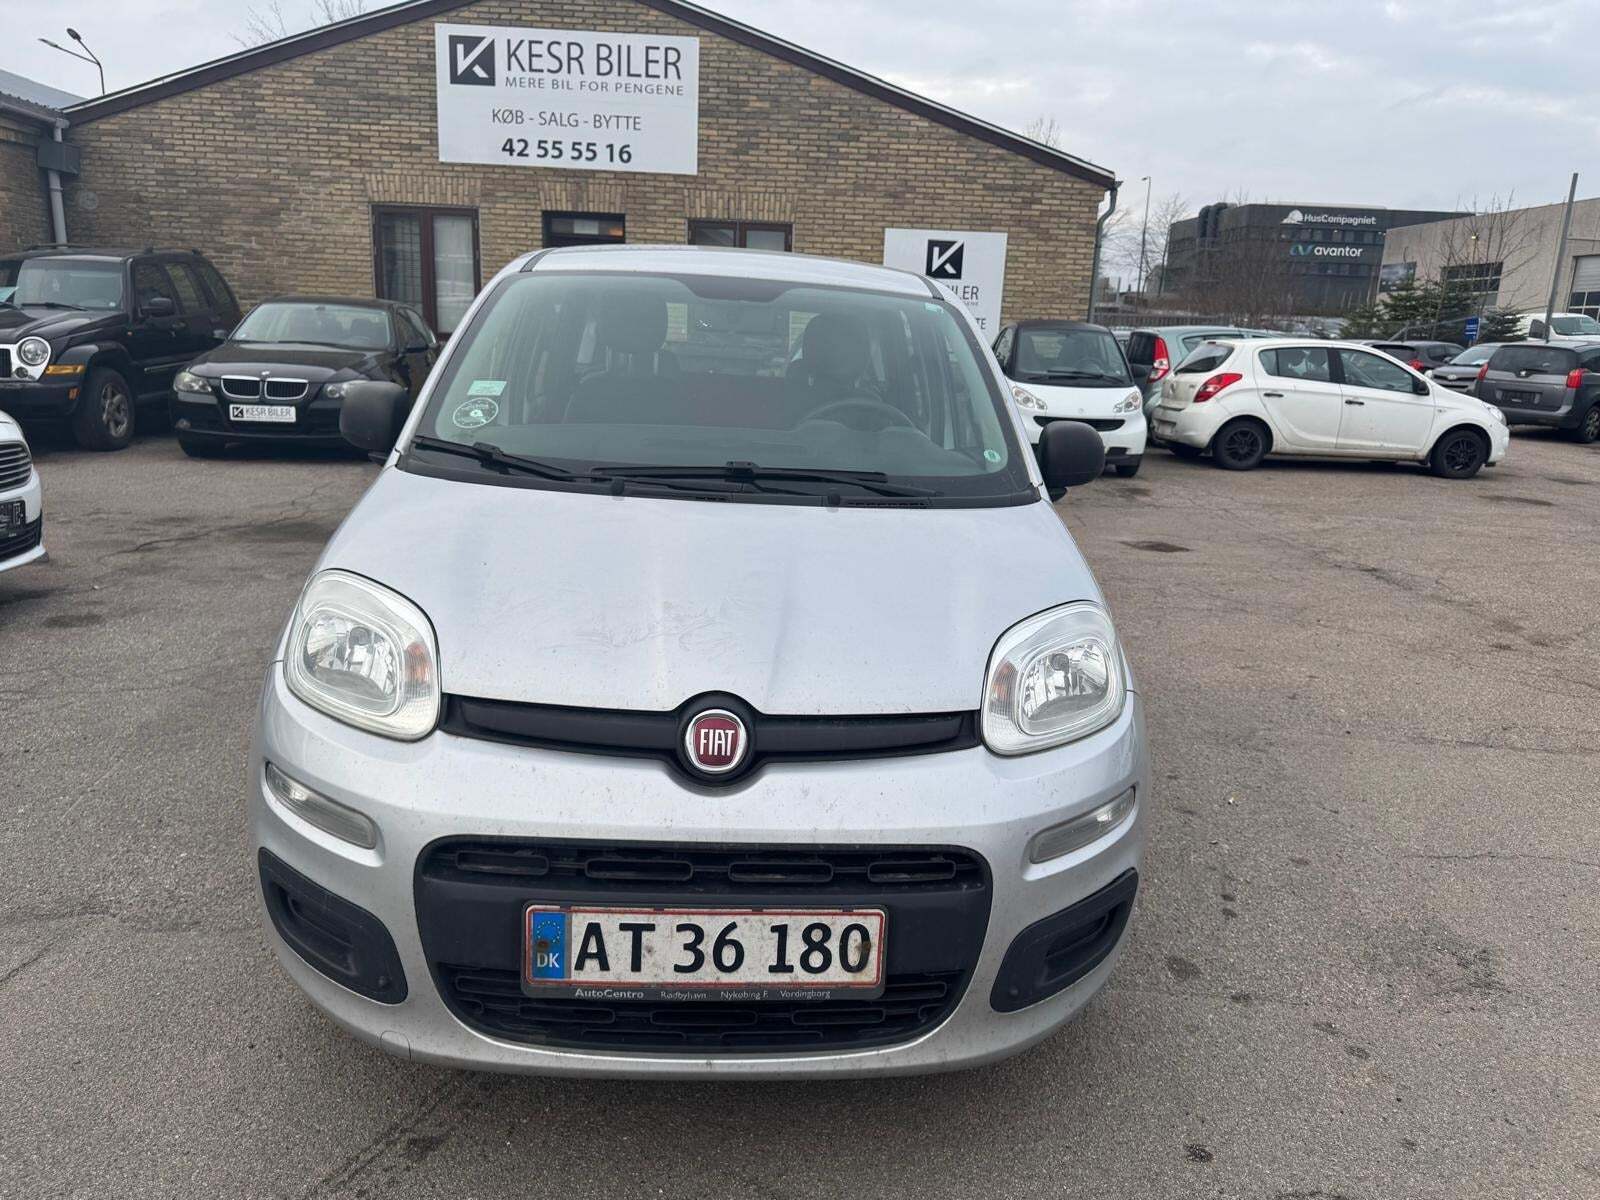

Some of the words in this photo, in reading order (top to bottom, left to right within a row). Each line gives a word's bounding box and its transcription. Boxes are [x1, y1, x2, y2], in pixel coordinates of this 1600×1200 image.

[506, 38, 585, 75] KESR
[596, 44, 682, 80] BILER
[505, 76, 545, 89] MERE
[551, 79, 573, 90] BIL
[580, 80, 609, 92] FOR
[615, 82, 684, 96] PENGENE
[492, 107, 524, 125] KØB
[538, 111, 579, 128] SALG
[593, 114, 642, 131] BYTTE
[501, 138, 529, 158] 42
[536, 140, 563, 159] 55
[570, 142, 597, 161] 55
[605, 143, 632, 164] 16
[1304, 214, 1376, 226] HusCompagniet
[1314, 245, 1363, 257] avantor
[700, 728, 735, 756] FIAT
[574, 921, 656, 972] AT
[673, 921, 745, 974] 36
[768, 922, 872, 974] 180
[536, 952, 560, 969] DK
